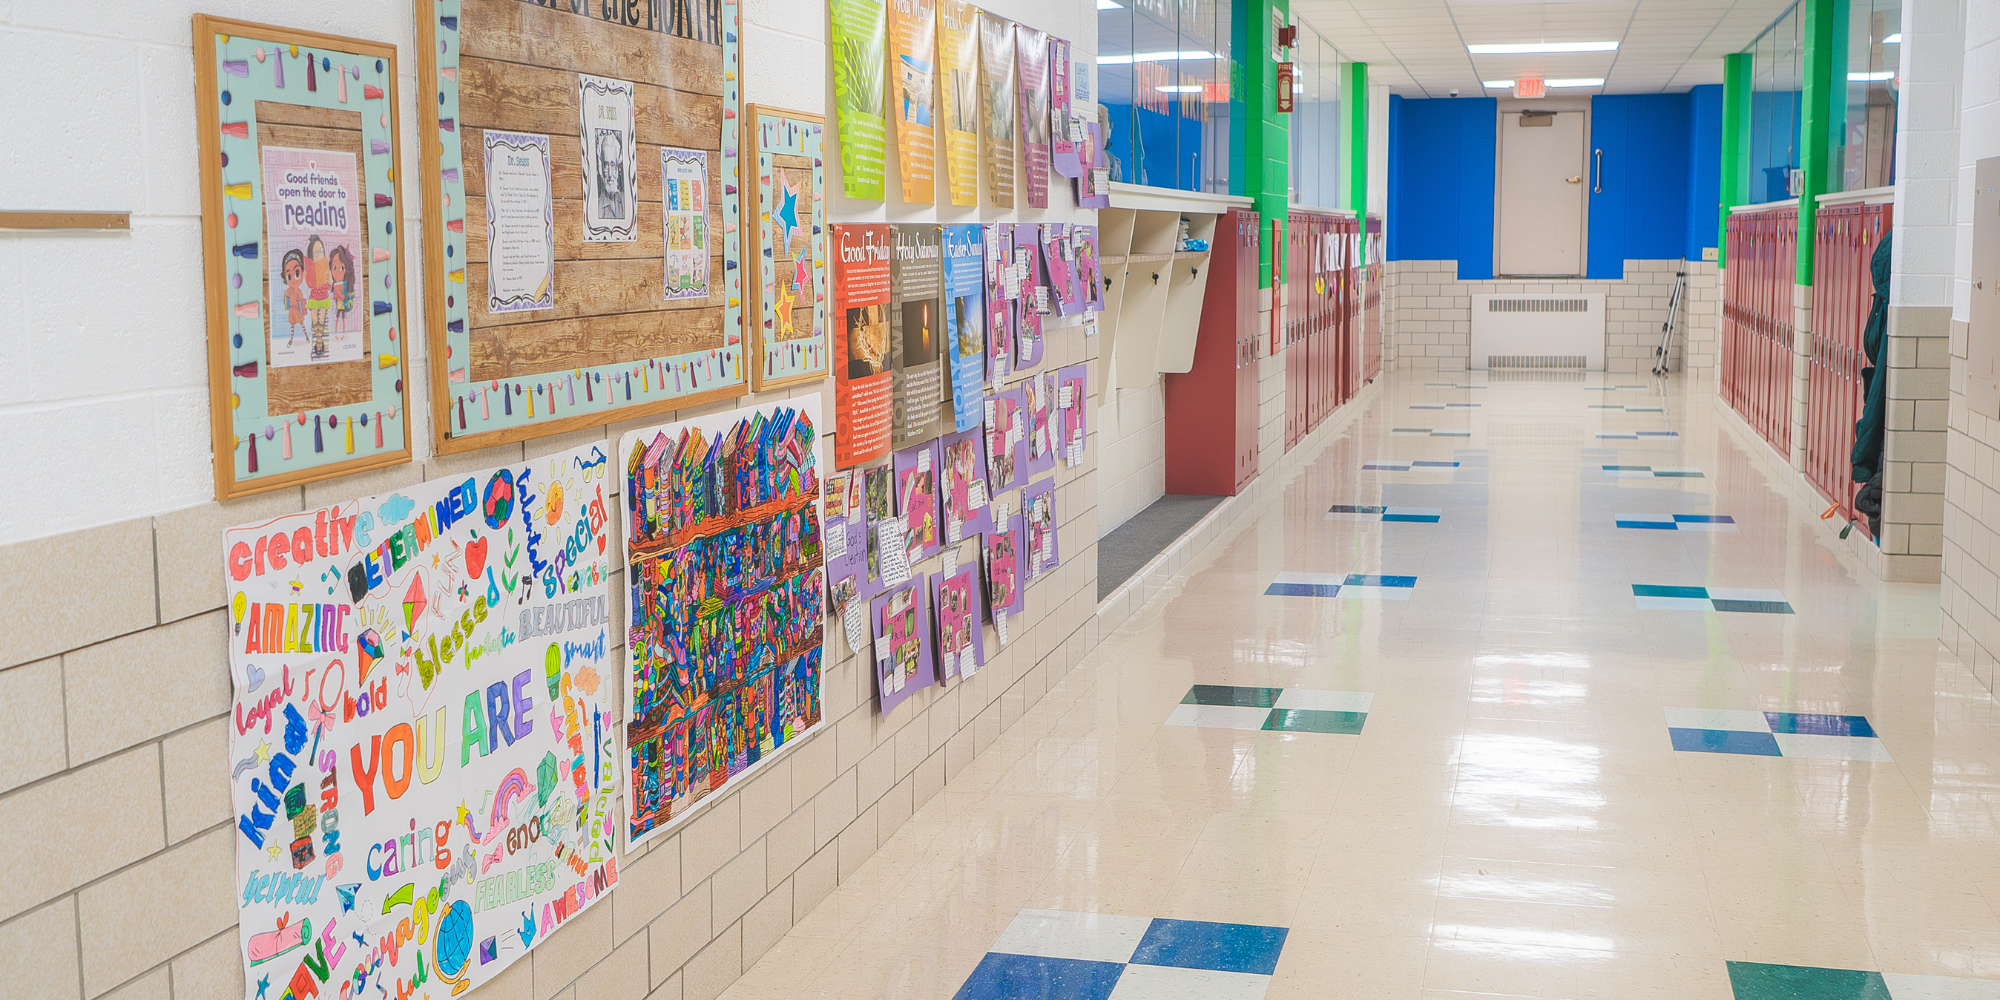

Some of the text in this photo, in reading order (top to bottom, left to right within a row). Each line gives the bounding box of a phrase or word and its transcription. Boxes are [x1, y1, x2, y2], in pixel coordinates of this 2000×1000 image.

[1519, 78, 1542, 97] EXIT
[279, 186, 346, 200] open the door to
[286, 173, 338, 186] Good friends
[285, 200, 347, 230] reading
[841, 230, 890, 265] Good Friday
[896, 232, 938, 263] Holy Saturday
[230, 505, 374, 581] creative
[348, 477, 478, 604] DETERMINED
[245, 602, 350, 654] AMAZING
[414, 565, 500, 692] blessed
[518, 594, 608, 642] BEAUTIFUL
[464, 625, 516, 670] fantastic
[564, 627, 606, 669] smart
[236, 664, 295, 736] loyal
[344, 677, 387, 723] bold
[351, 668, 533, 816] YOU ARE
[239, 703, 309, 850] kind
[589, 737, 614, 864] valued
[319, 750, 343, 880] STRONG
[367, 818, 452, 881] caring
[242, 869, 327, 908] helpful
[474, 860, 556, 914] FEARLESS
[540, 856, 618, 938] AWESOME
